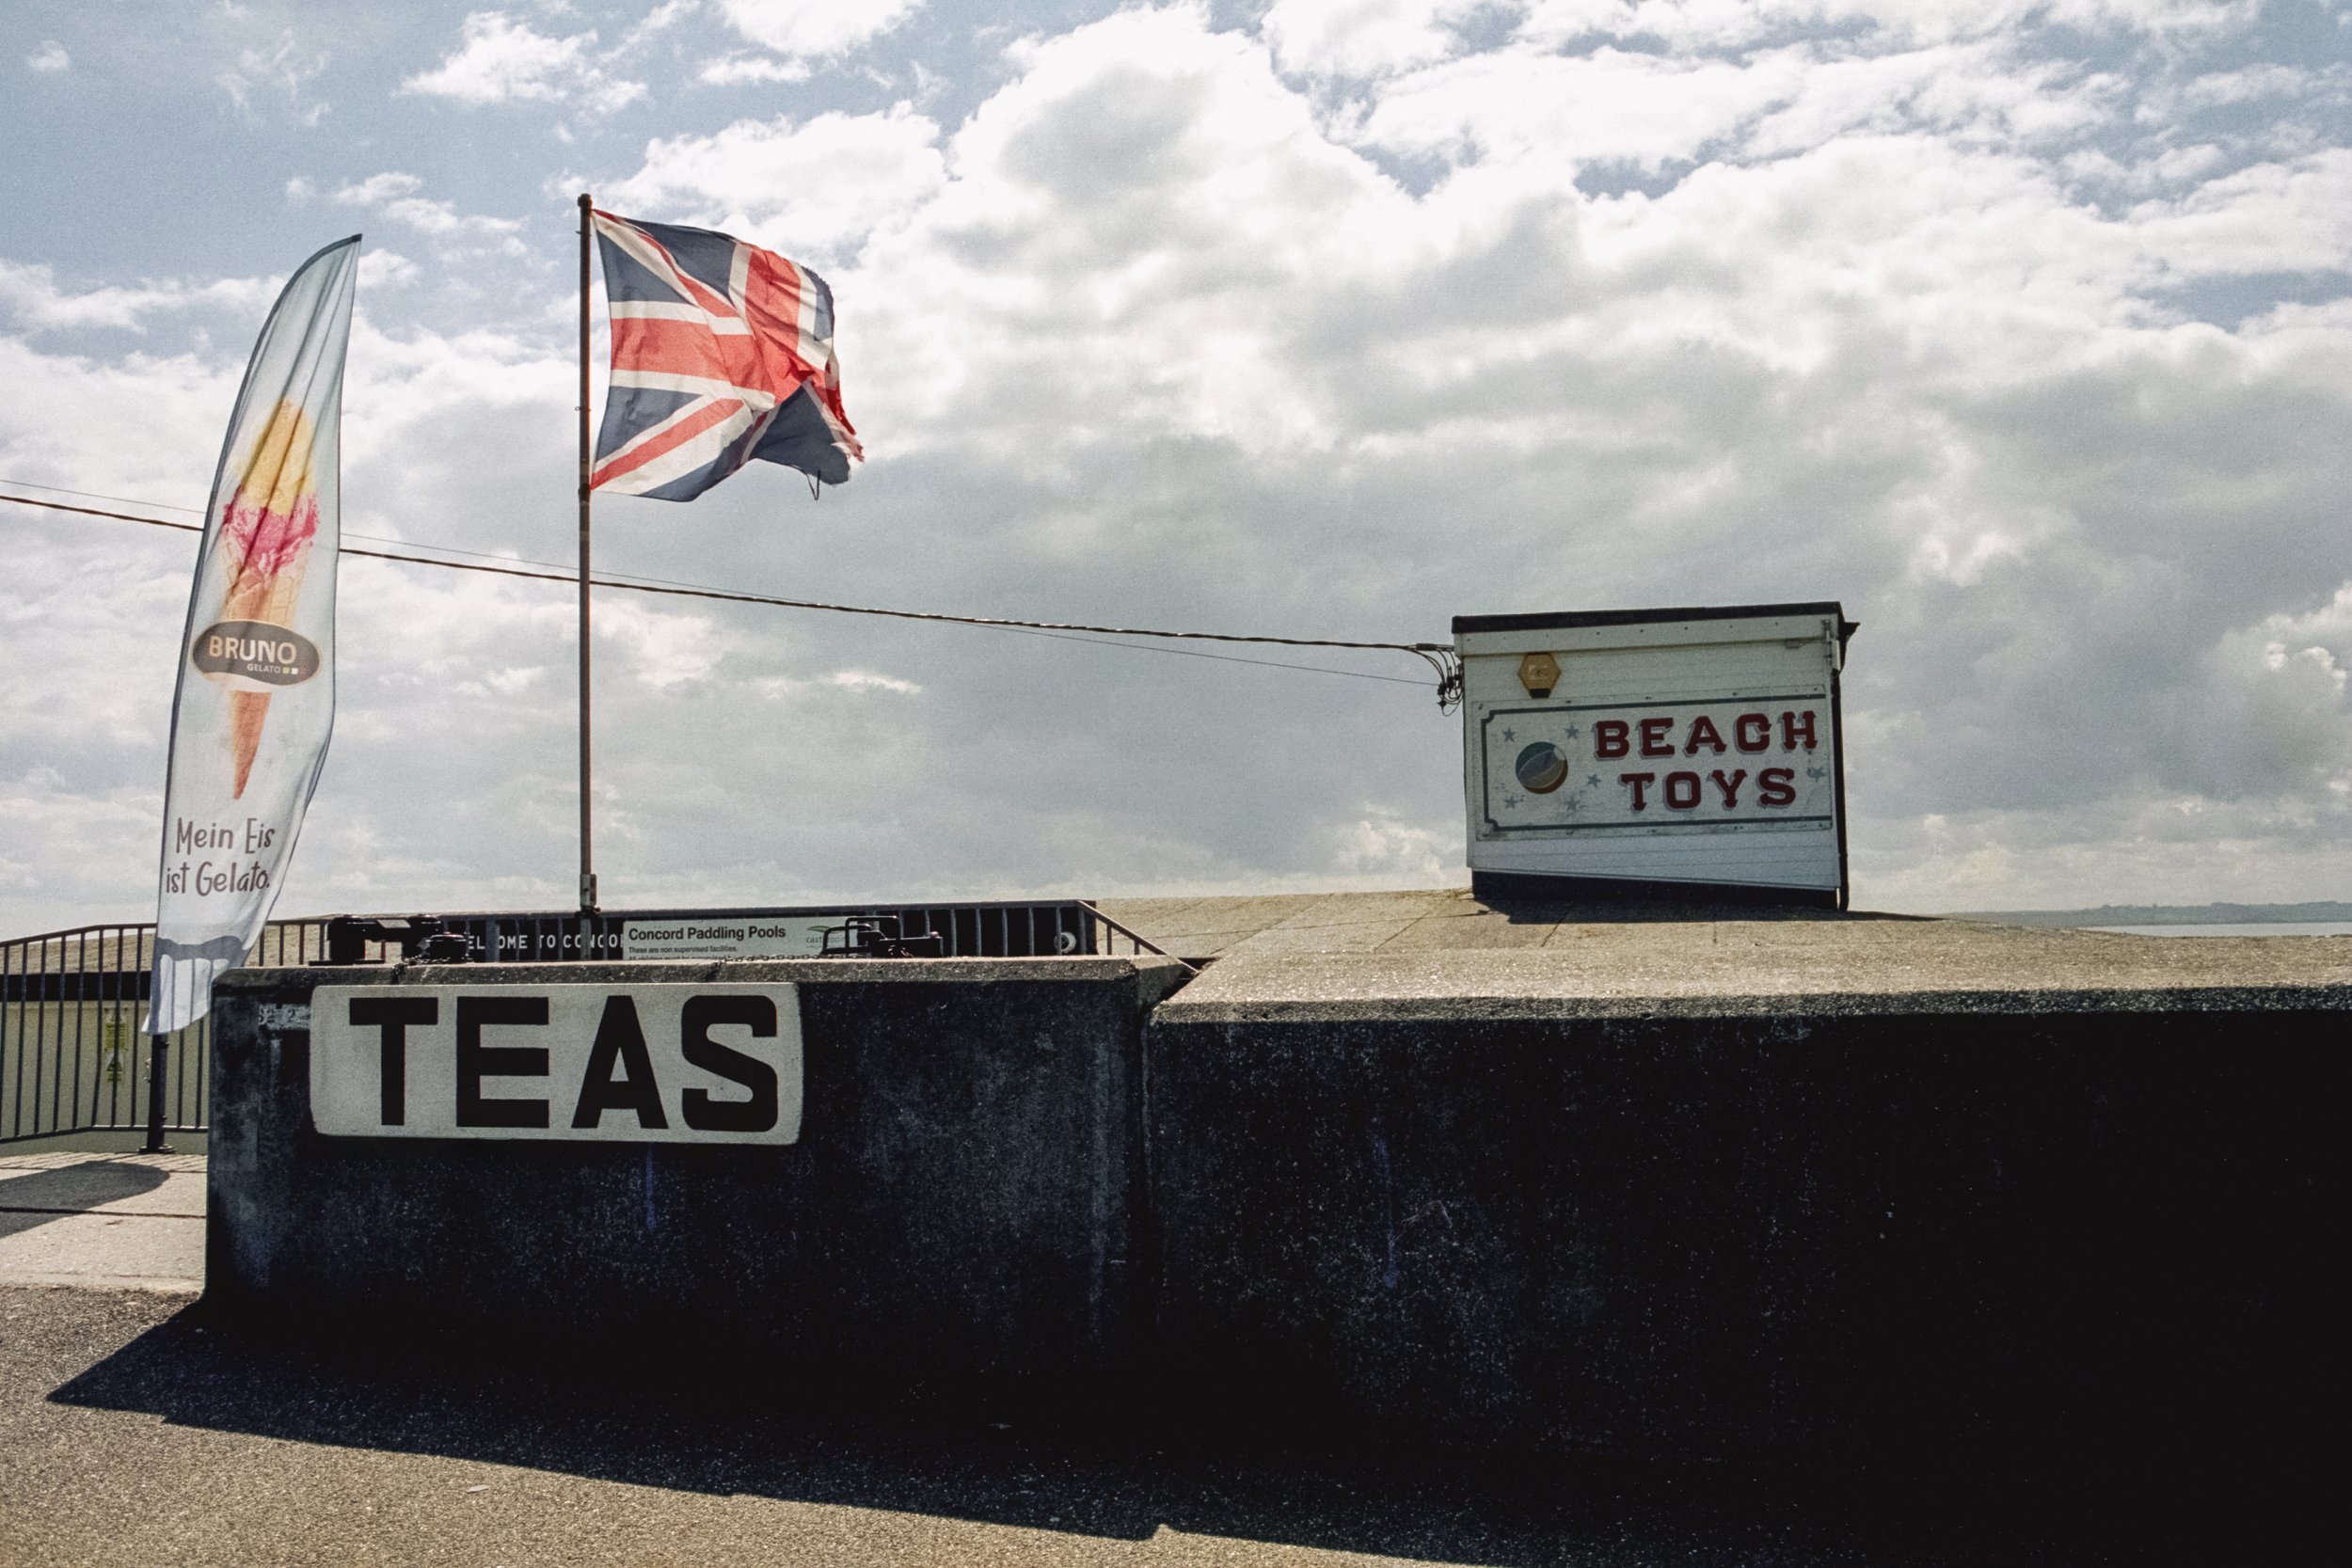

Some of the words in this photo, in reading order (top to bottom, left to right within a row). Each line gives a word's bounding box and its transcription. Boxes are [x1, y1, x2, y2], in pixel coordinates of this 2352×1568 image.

[208, 635, 297, 665] BRUNO
[246, 662, 281, 674] GELATO
[1594, 709, 1819, 761] BEACH
[1619, 767, 1797, 812] TOYS
[176, 816, 234, 855] Mein
[245, 817, 275, 854] Eis
[166, 862, 190, 894] ist
[196, 861, 270, 896] Gelato.
[628, 927, 684, 941] Concord
[687, 927, 744, 942] Paddling
[748, 925, 787, 939] Pools
[349, 994, 779, 1132] TEAS
